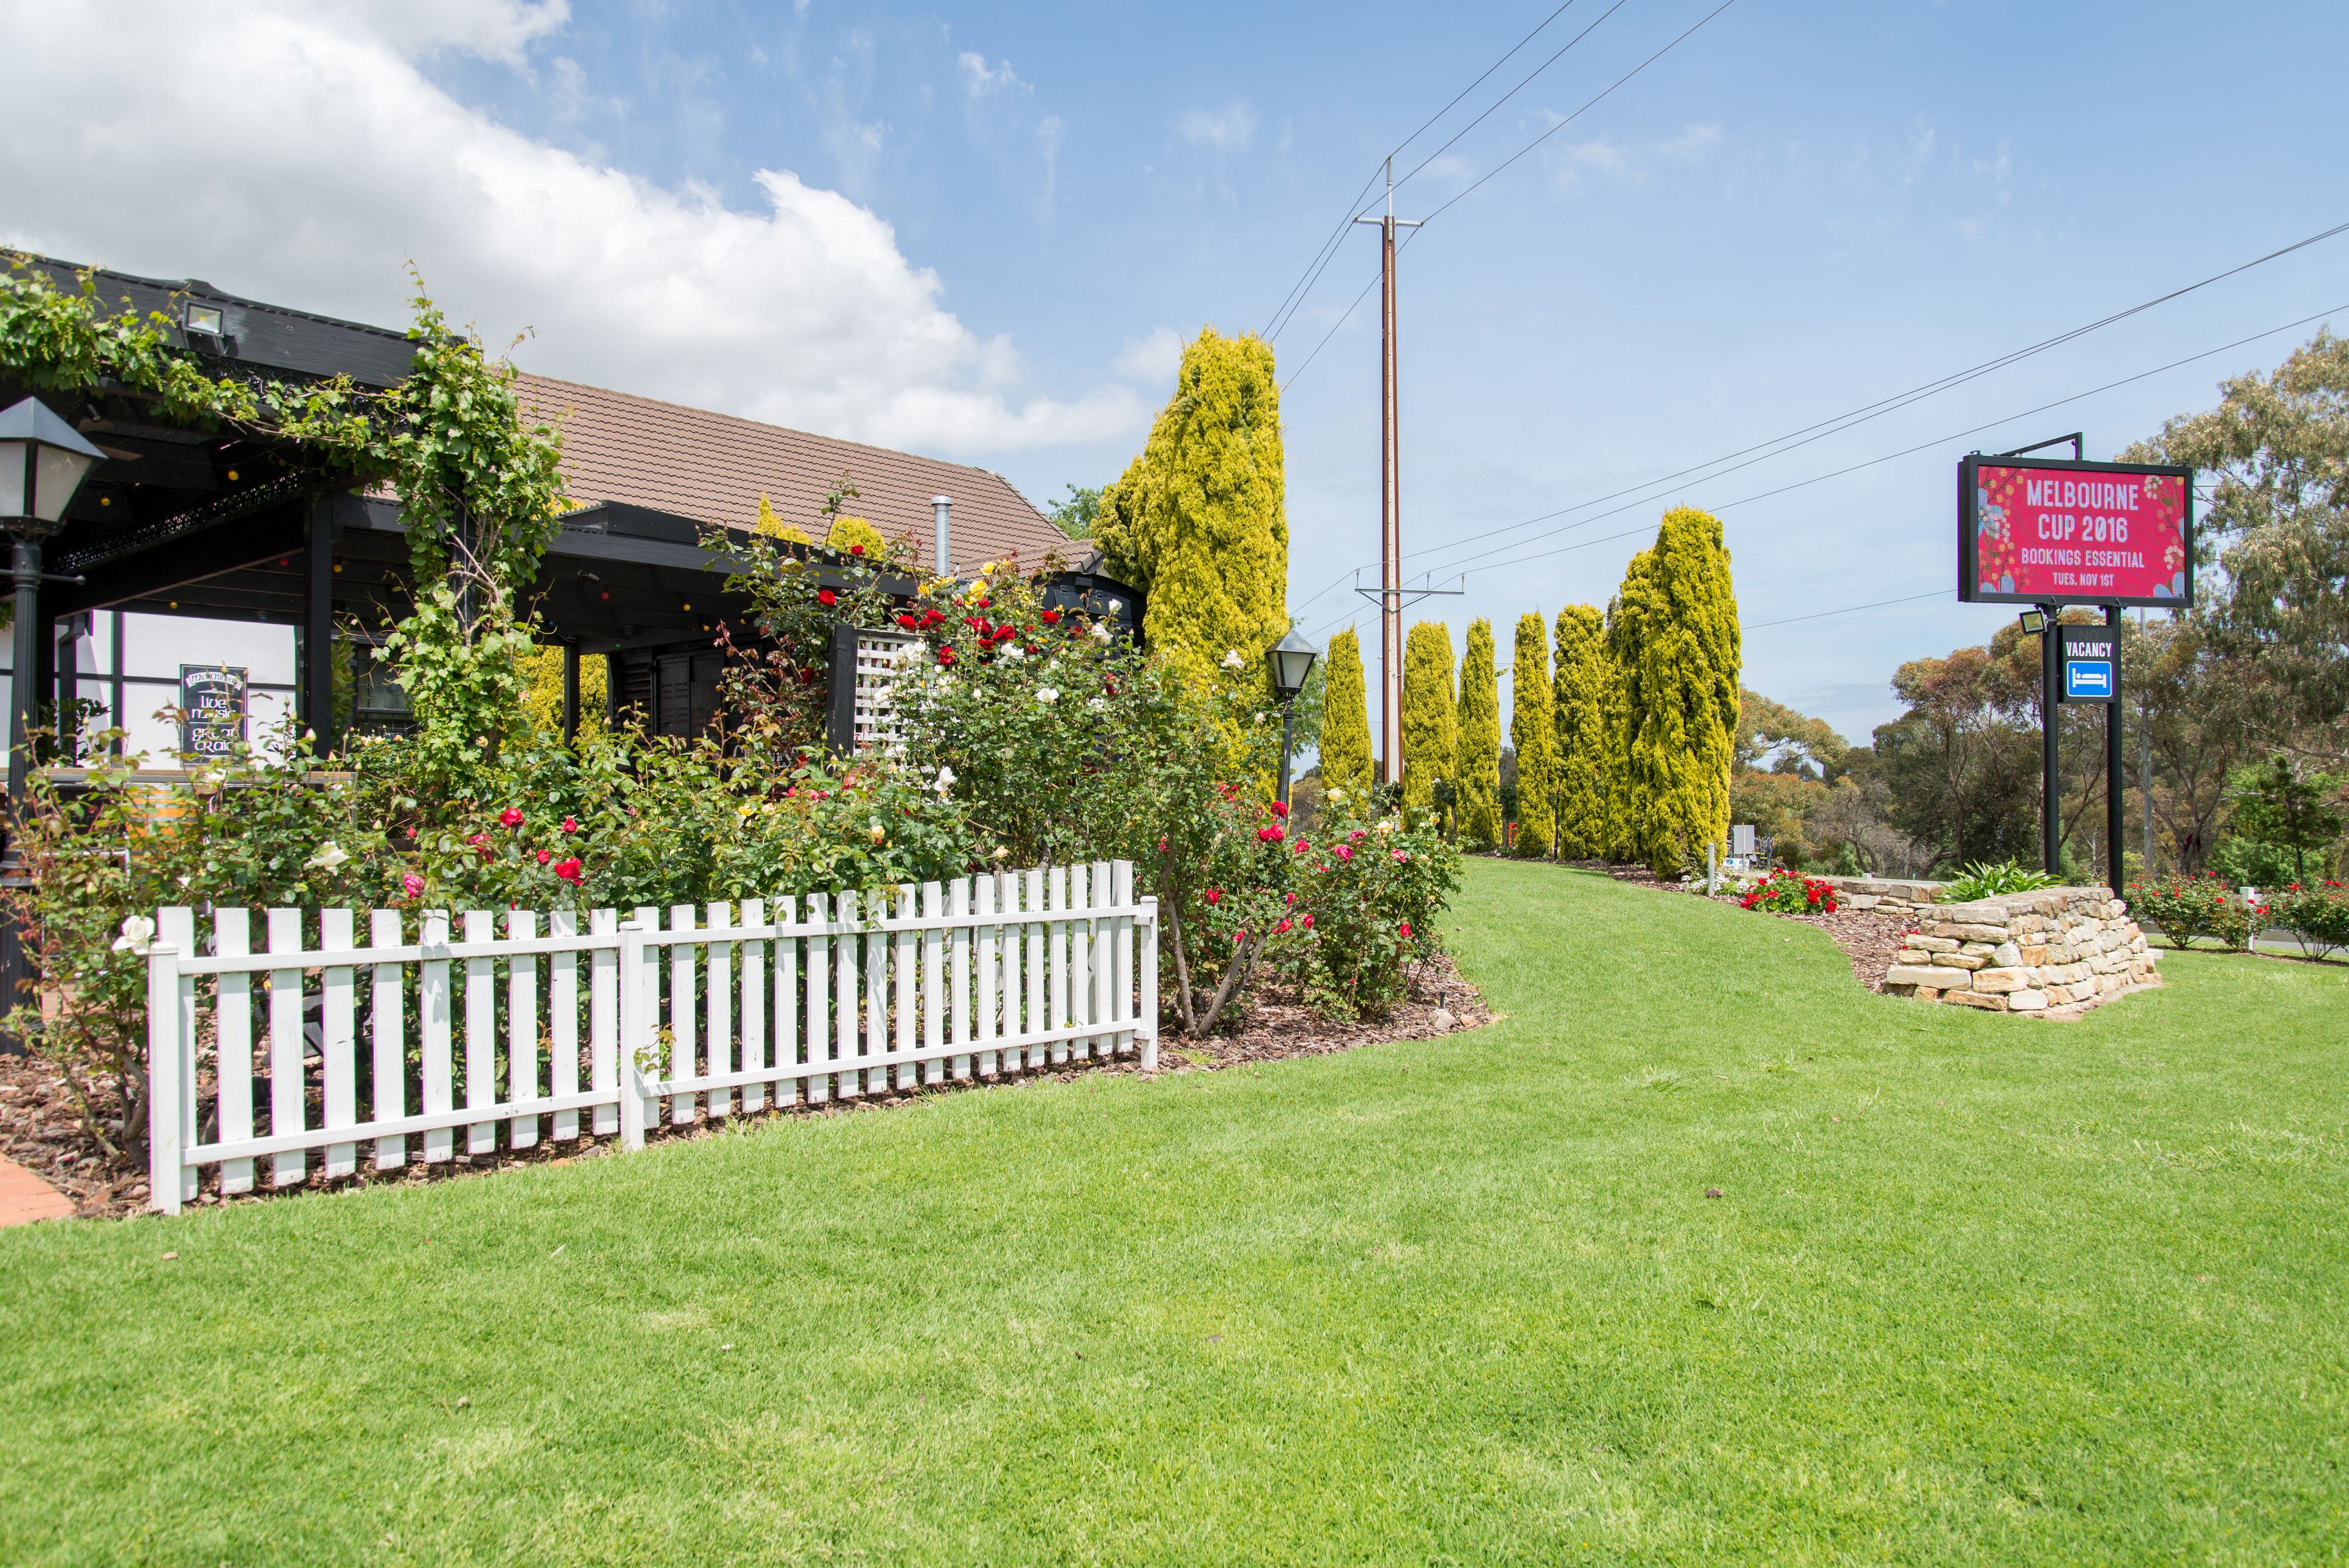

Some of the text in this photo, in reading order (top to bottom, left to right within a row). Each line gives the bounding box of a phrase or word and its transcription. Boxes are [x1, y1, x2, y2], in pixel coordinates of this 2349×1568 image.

[2027, 479, 2139, 510] MELBOURNE
[2038, 513, 2128, 543] CUP 2016
[2021, 548, 2145, 568] BOOKINGS ESSENTIAL
[2052, 571, 2114, 587] TUES. NOV 1ST
[2079, 630, 2099, 641] NO
[2065, 642, 2112, 658] VACANCY
[191, 708, 236, 719] msic
